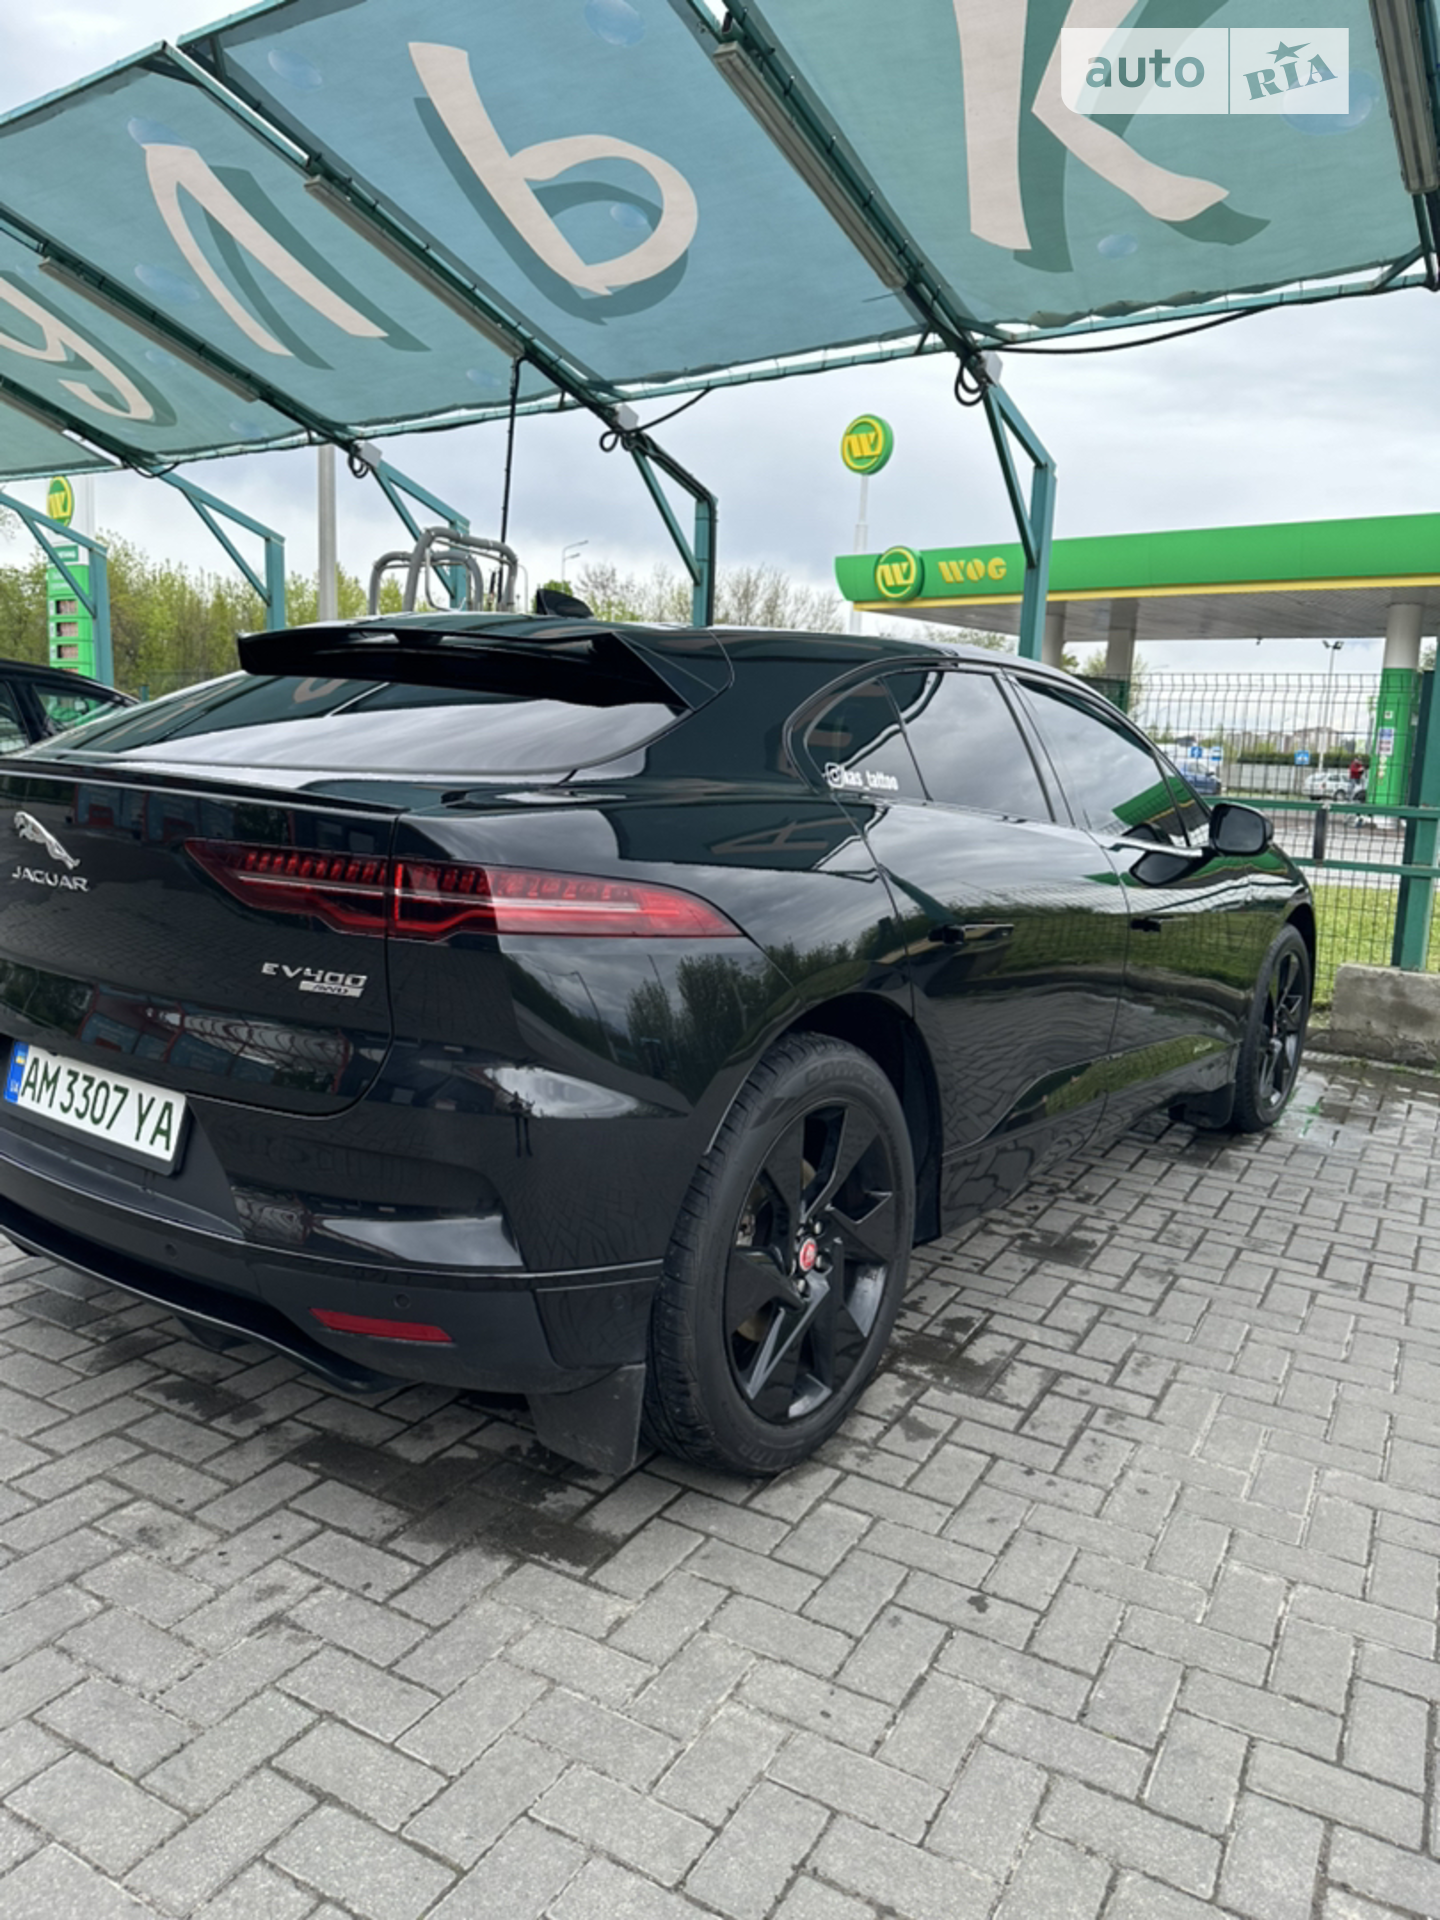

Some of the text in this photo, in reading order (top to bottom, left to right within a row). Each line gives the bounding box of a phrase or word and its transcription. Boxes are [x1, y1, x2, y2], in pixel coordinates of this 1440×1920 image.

[938, 557, 1007, 583] WOG
[12, 865, 89, 892] JAGUAR
[261, 962, 367, 987] EV400
[135, 1092, 174, 1152] YA
